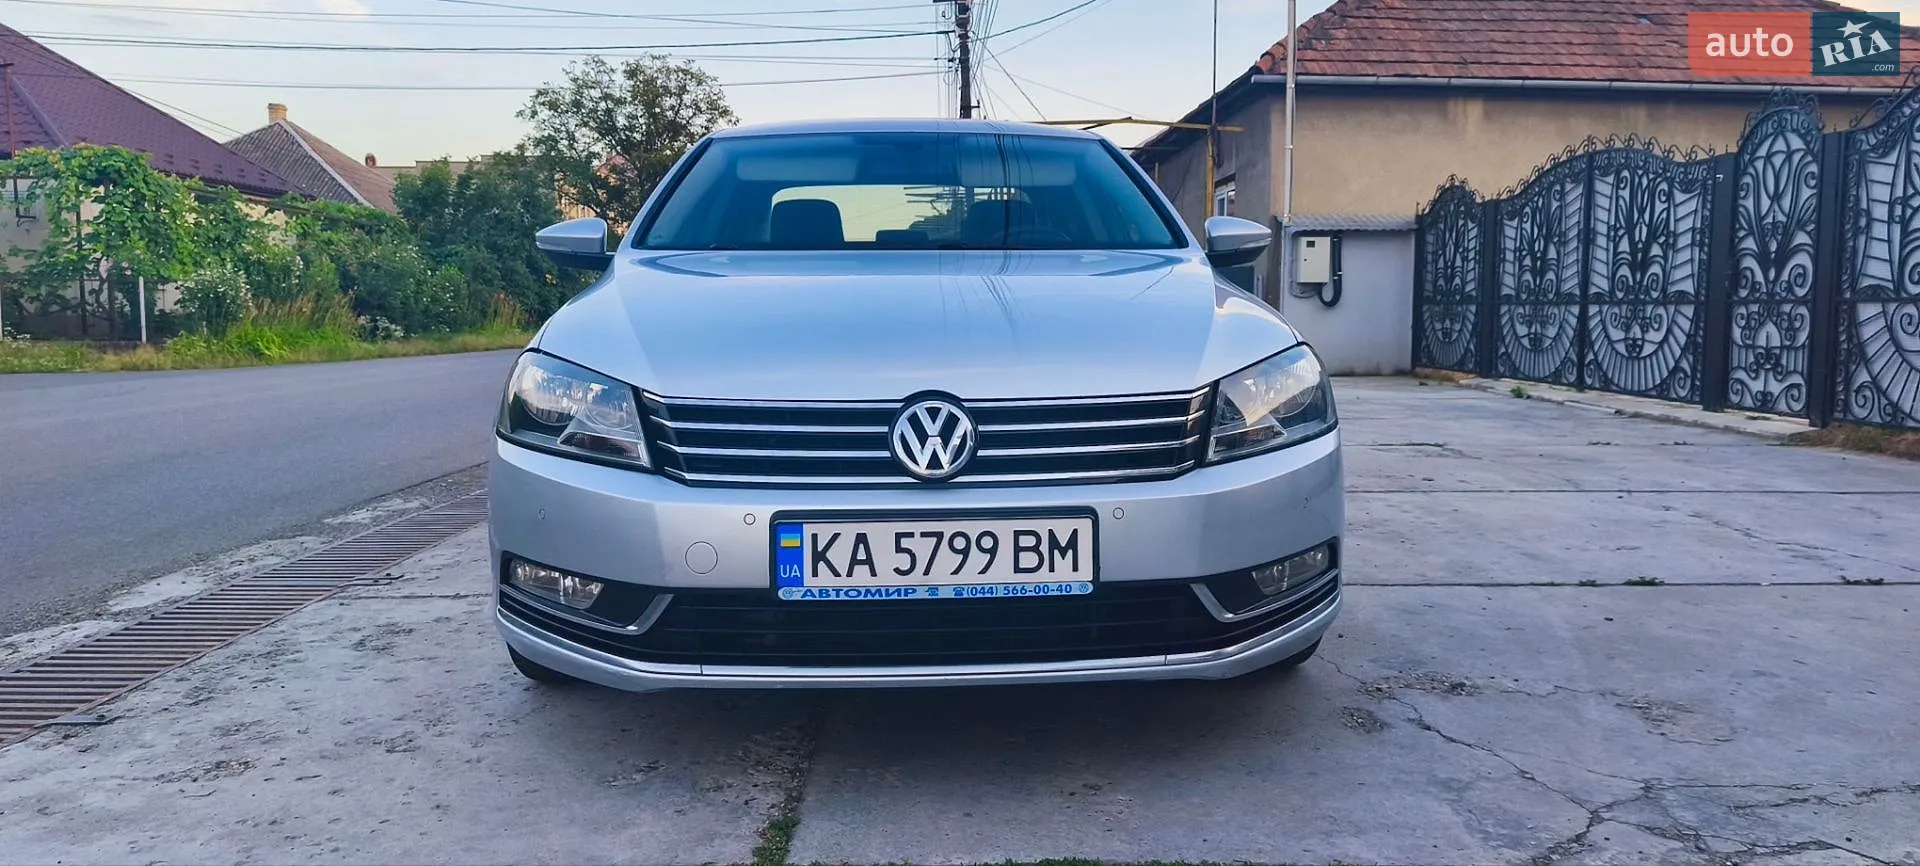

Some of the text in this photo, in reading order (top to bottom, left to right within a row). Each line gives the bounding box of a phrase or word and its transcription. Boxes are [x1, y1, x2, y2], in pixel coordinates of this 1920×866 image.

[810, 528, 1080, 578] KA 5799 BM
[780, 564, 801, 578] UA
[800, 587, 918, 599] АВТОМИР
[966, 583, 1073, 596] (044) 566-00-40
